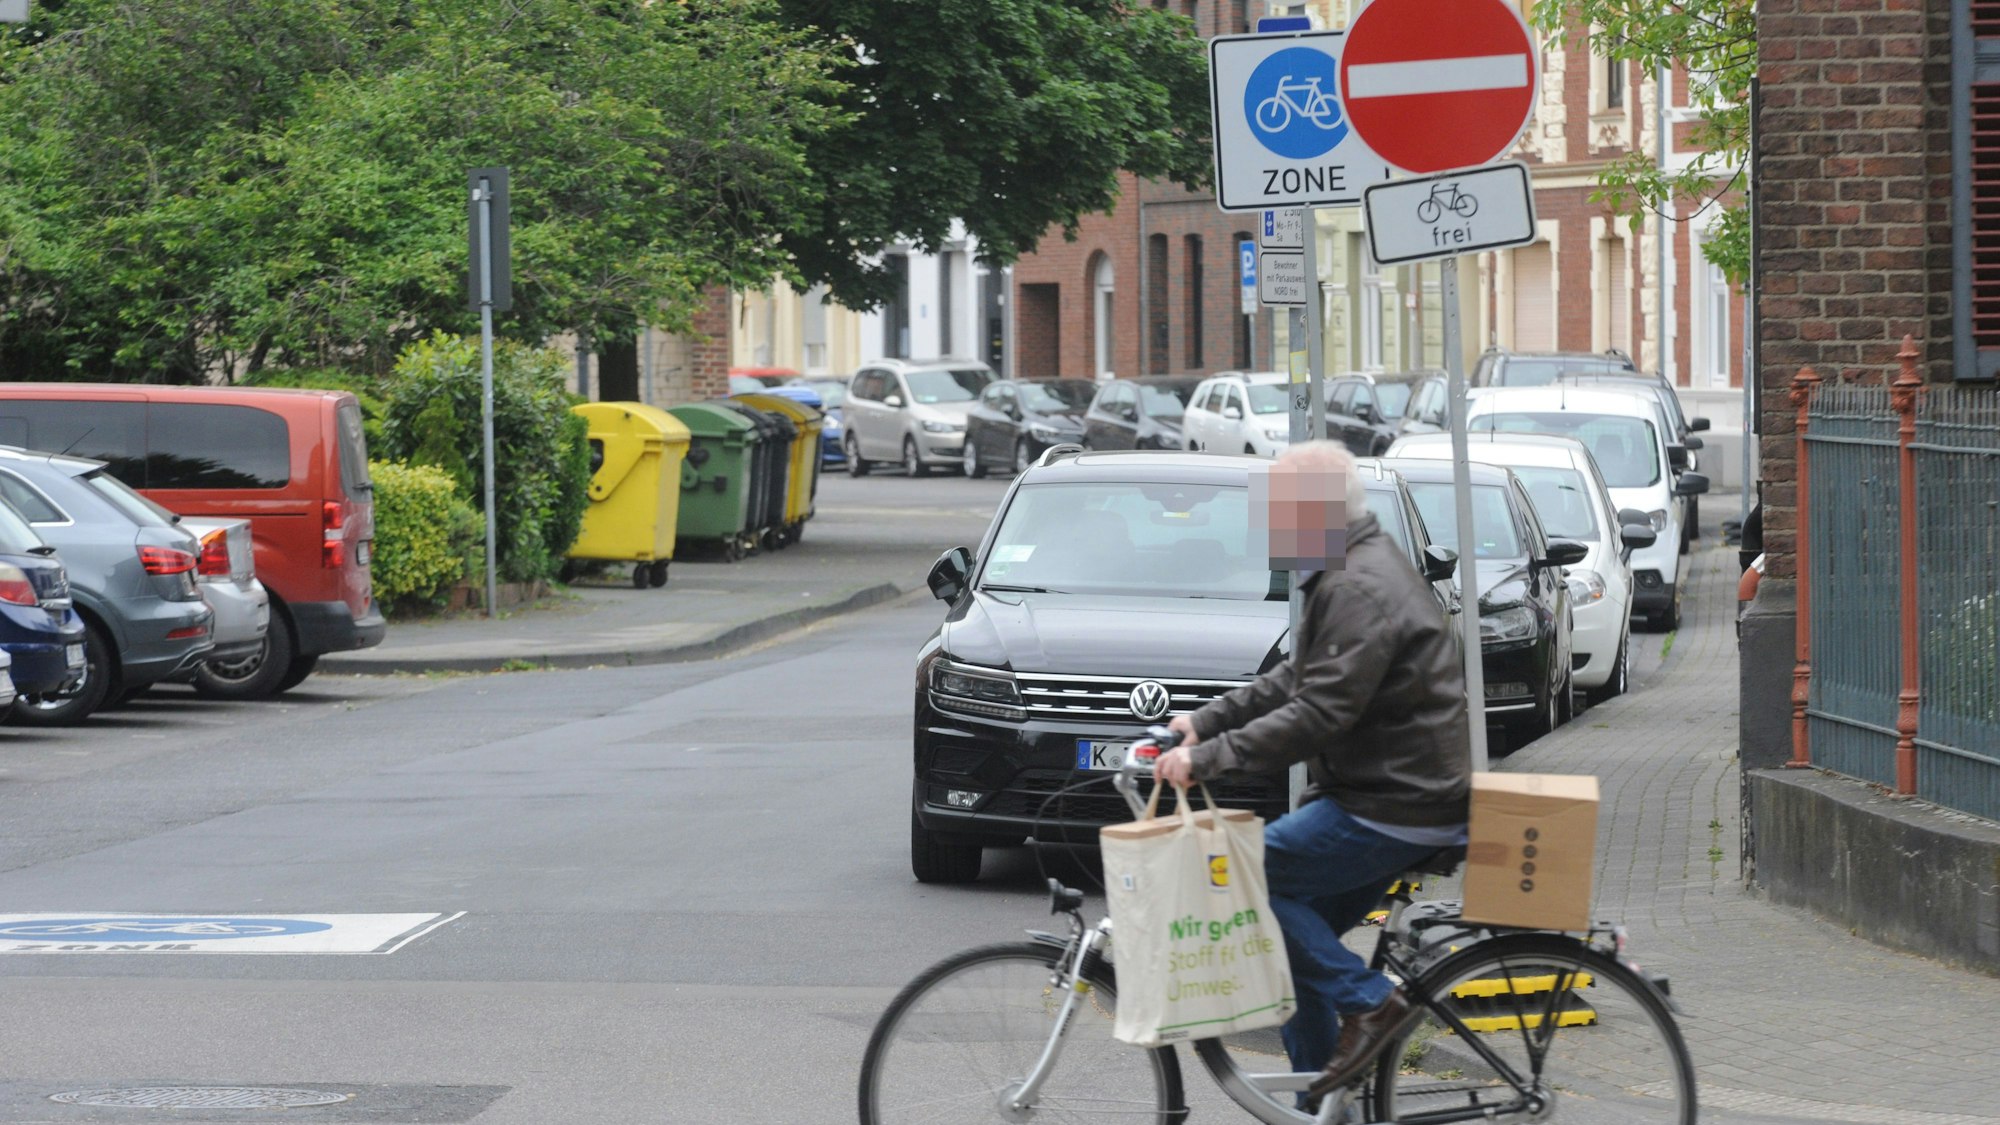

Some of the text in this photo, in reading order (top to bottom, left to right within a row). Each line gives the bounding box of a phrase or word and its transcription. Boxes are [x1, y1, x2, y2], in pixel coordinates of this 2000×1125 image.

[1263, 165, 1346, 195] ZONE
[1432, 221, 1473, 247] frei
[1274, 260, 1298, 270] Bewohner
[1266, 274, 1275, 282] mit
[1093, 745, 1107, 767] K
[1242, 932, 1273, 957] die
